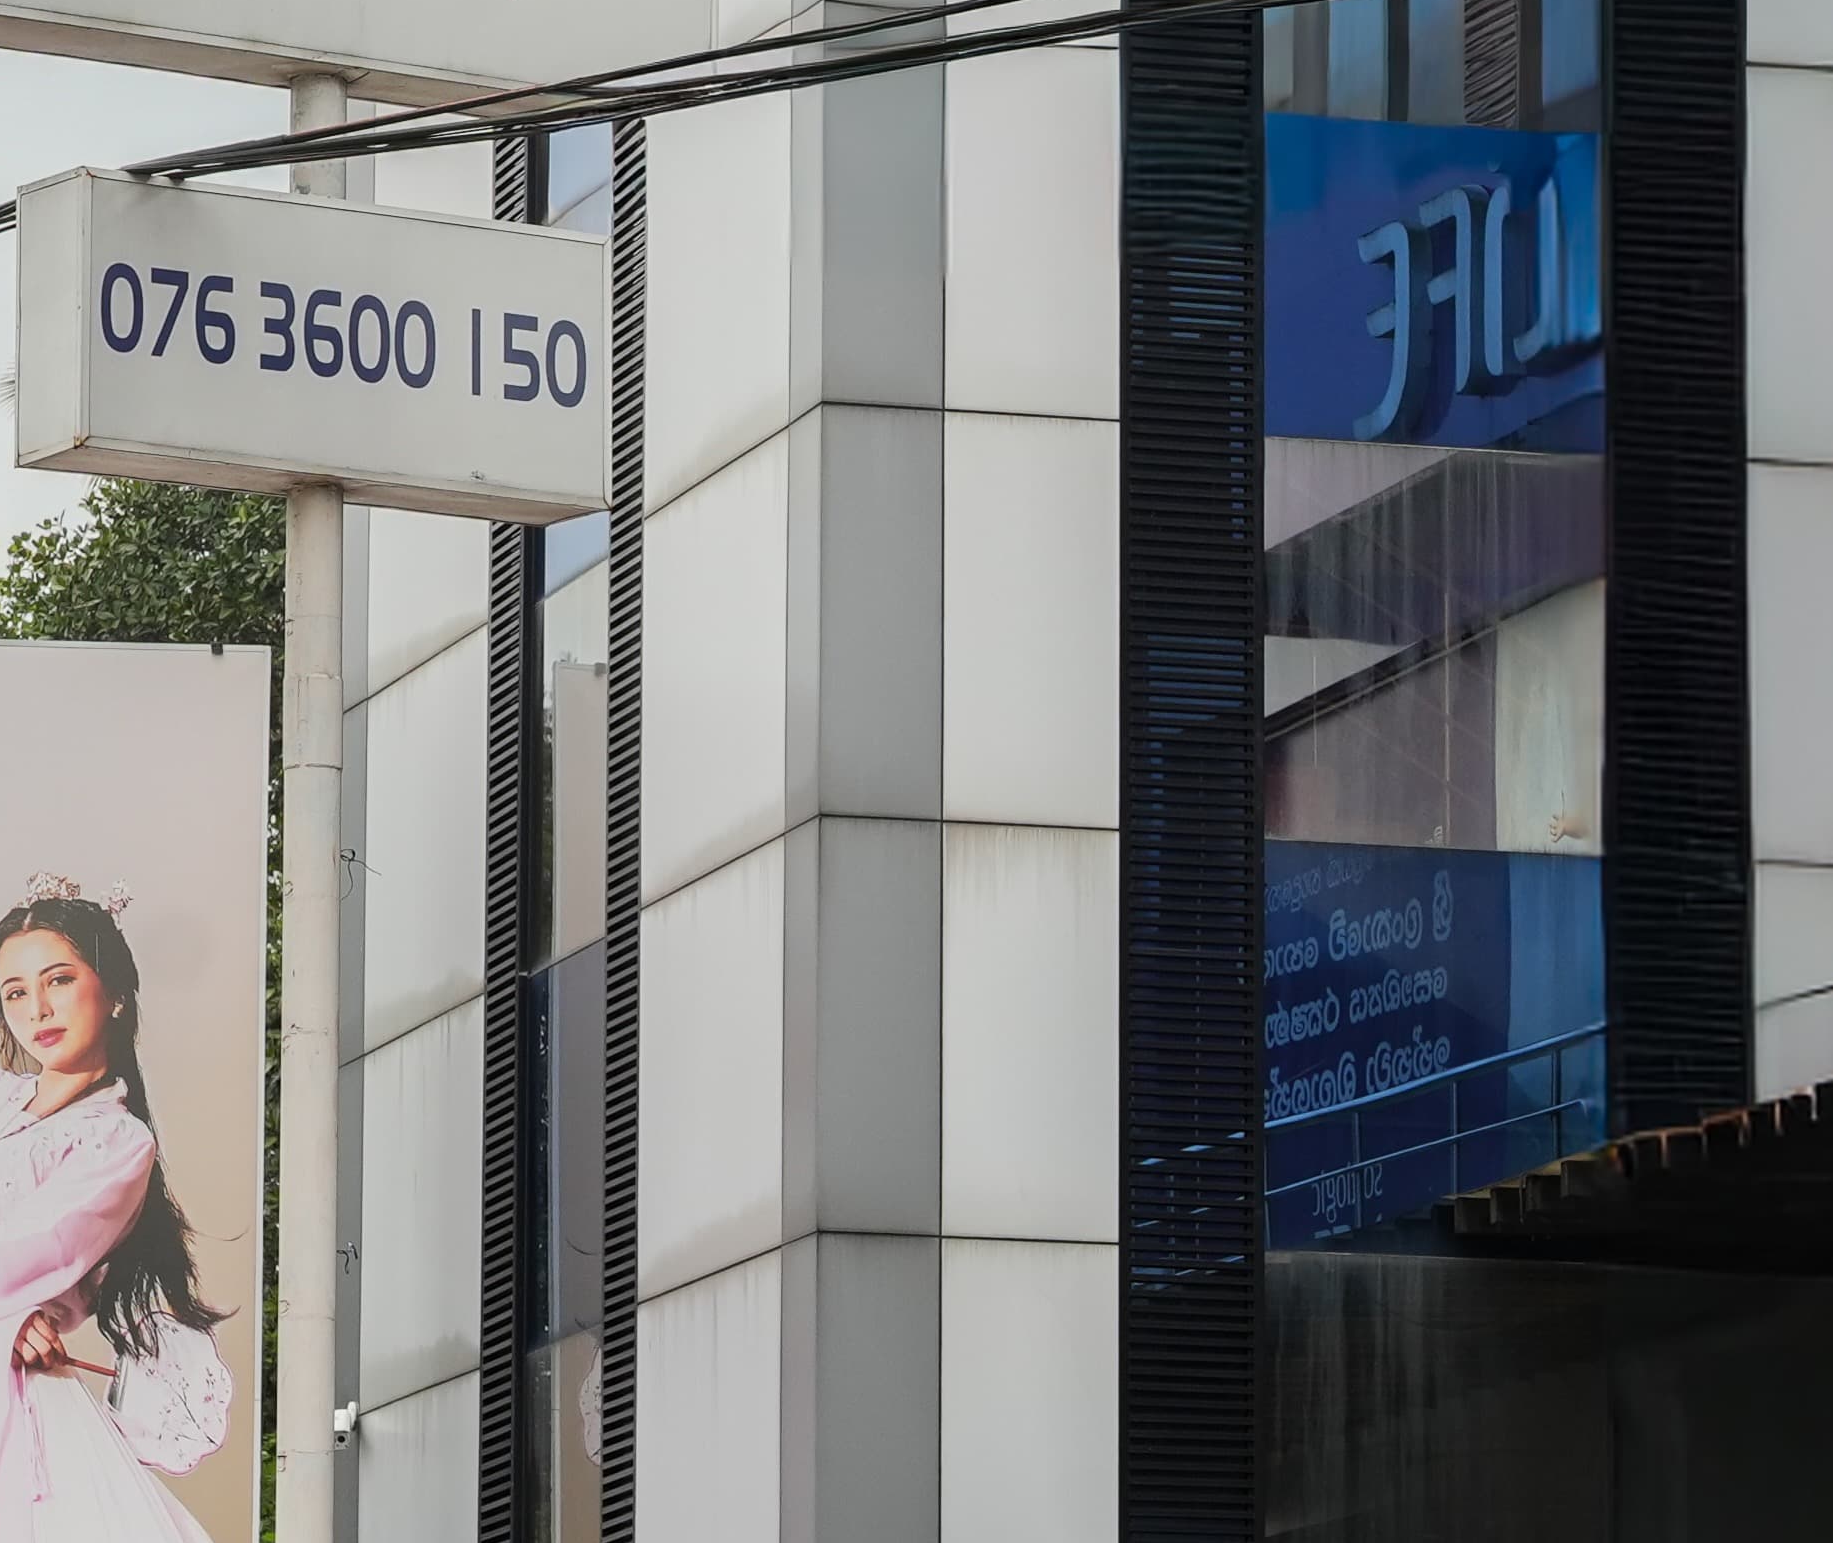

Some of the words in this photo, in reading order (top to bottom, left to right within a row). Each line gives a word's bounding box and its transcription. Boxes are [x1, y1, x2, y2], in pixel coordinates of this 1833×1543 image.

[100, 262, 236, 365] 076
[259, 281, 436, 390] 3600
[470, 308, 588, 409] 150
